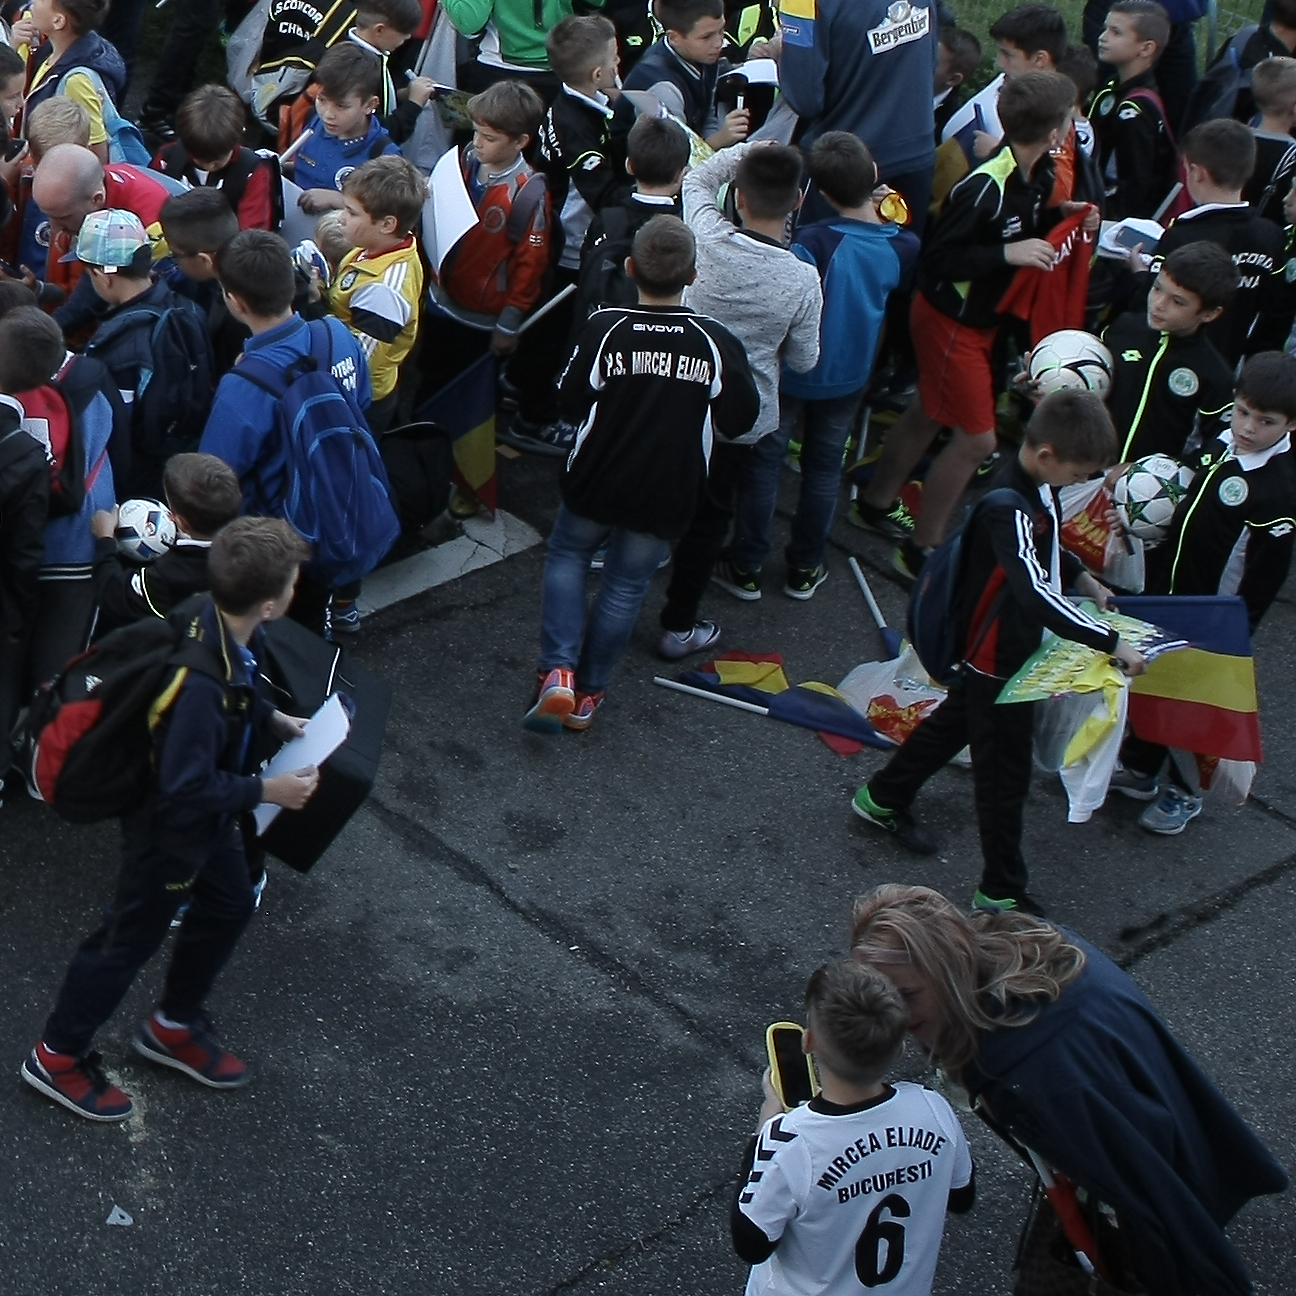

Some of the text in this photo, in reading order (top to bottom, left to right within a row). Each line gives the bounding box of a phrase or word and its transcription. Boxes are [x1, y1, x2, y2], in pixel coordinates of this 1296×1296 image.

[872, 13, 928, 48] Bergenbier
[632, 322, 685, 335] GIVOVA
[631, 350, 673, 378] MIRCEA
[817, 1126, 947, 1192] MIRCEA ELIADE
[837, 1159, 933, 1204] BUCURESTI
[855, 1192, 912, 1289] 6
